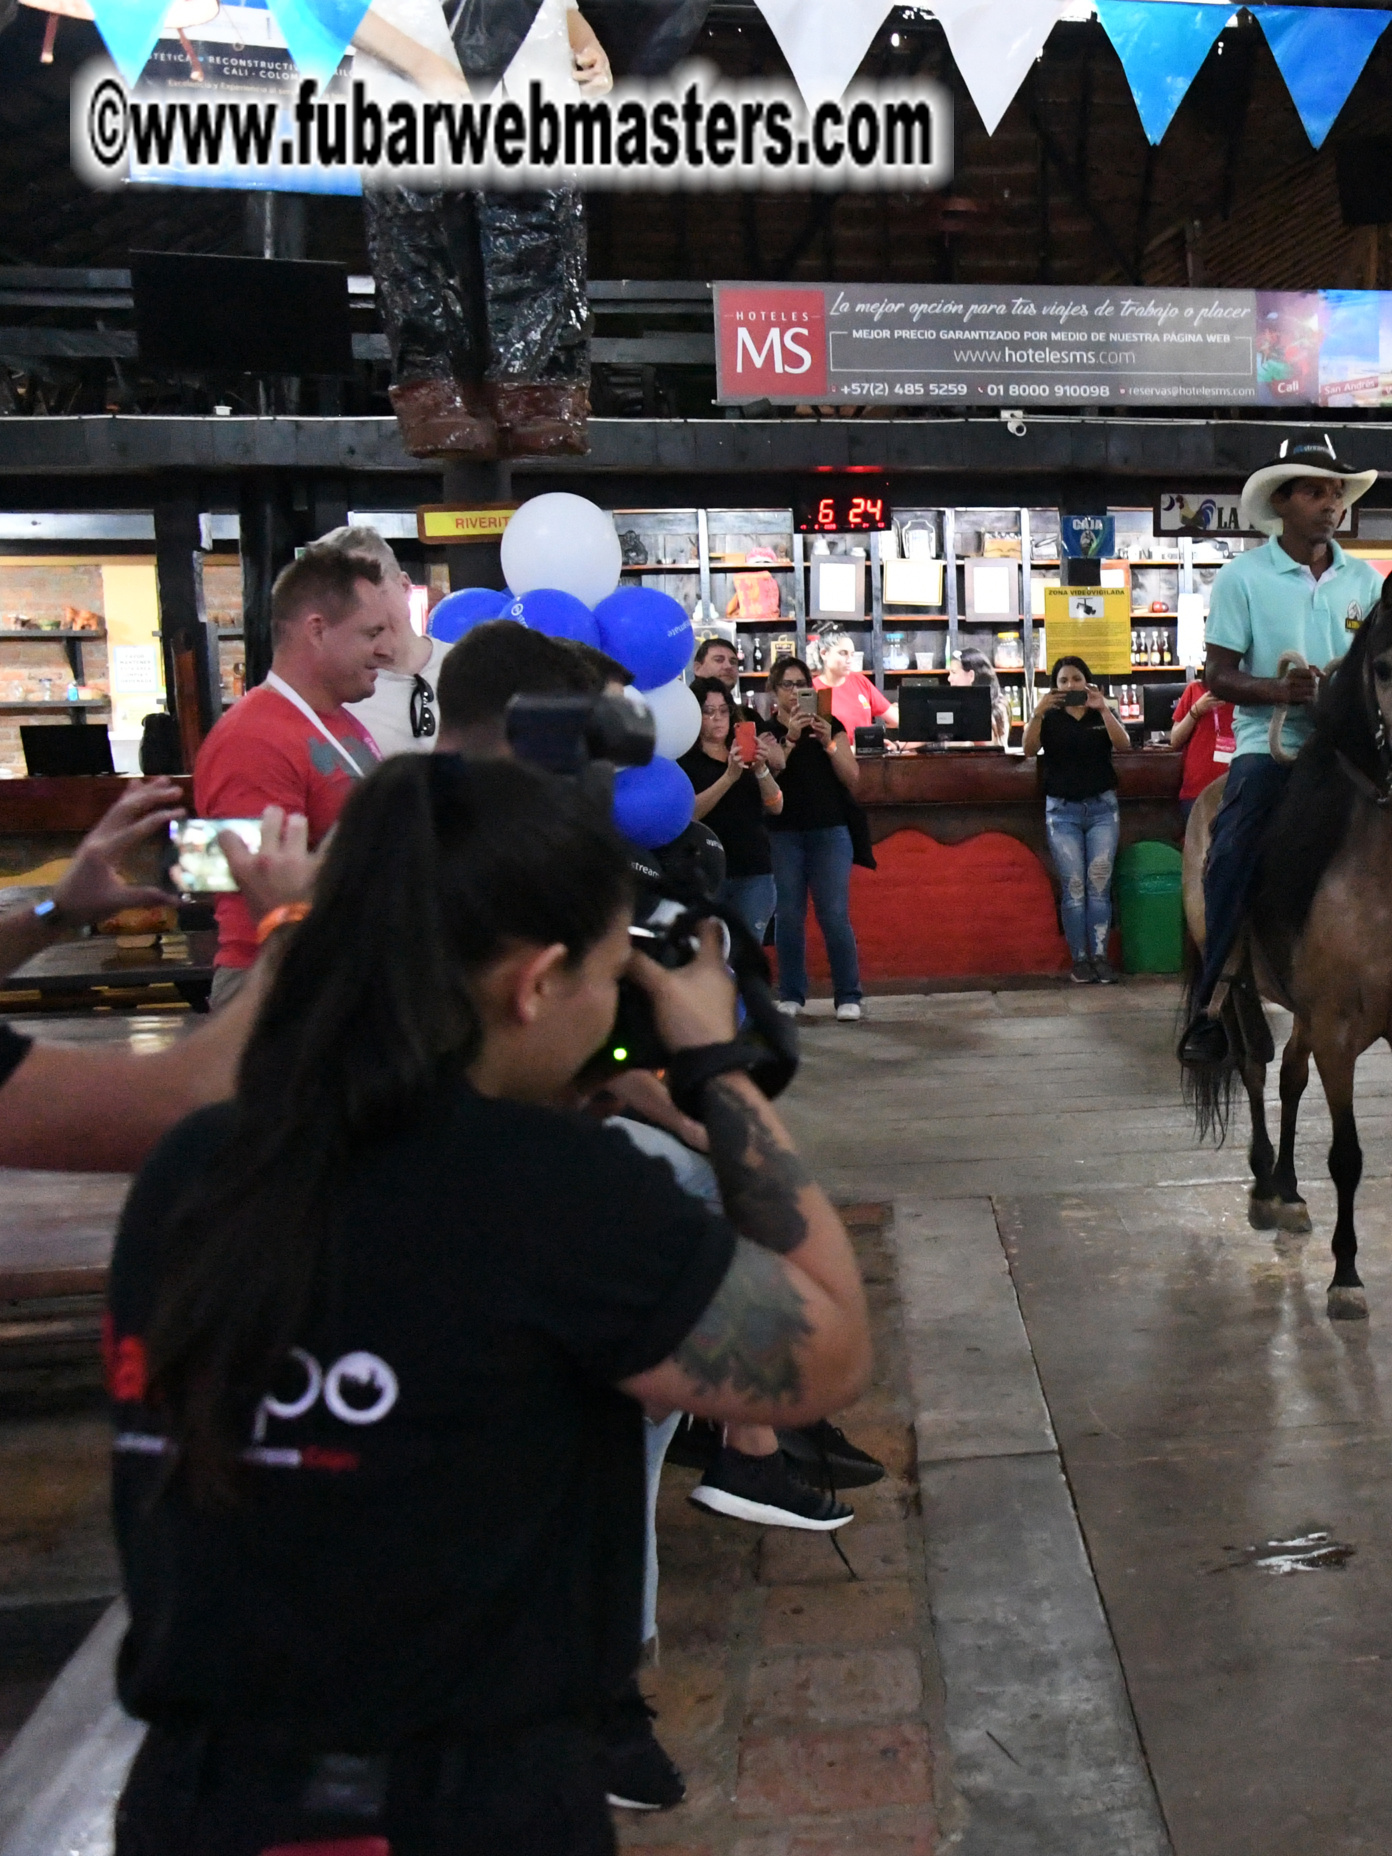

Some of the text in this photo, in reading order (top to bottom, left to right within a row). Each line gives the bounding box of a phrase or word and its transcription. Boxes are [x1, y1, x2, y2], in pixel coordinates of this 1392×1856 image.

[149, 51, 300, 72] TÉTICA RECONSTRUCTIV
[223, 66, 300, 81] CALI COLOM
[830, 291, 1252, 326] La mejor opción para tus viajes de trabajo o placer
[736, 311, 810, 322] HOTELES
[852, 329, 1231, 344] MEJOR PRECIO GARANTIZADO POR MEDIO DE NUESTRA PÁGINA WEB
[736, 326, 813, 375] MS
[953, 346, 1136, 365] www.hotelesms.com
[841, 382, 968, 398] +57(2) 485 5259
[987, 384, 1110, 398] 01 8000 910098
[1128, 384, 1256, 398] reservas@hotelesms.com
[1277, 381, 1300, 394] Cali
[1324, 384, 1341, 395] San
[455, 516, 510, 529] RIVERIT
[1072, 519, 1103, 531] CAJA
[1217, 507, 1239, 529] LA
